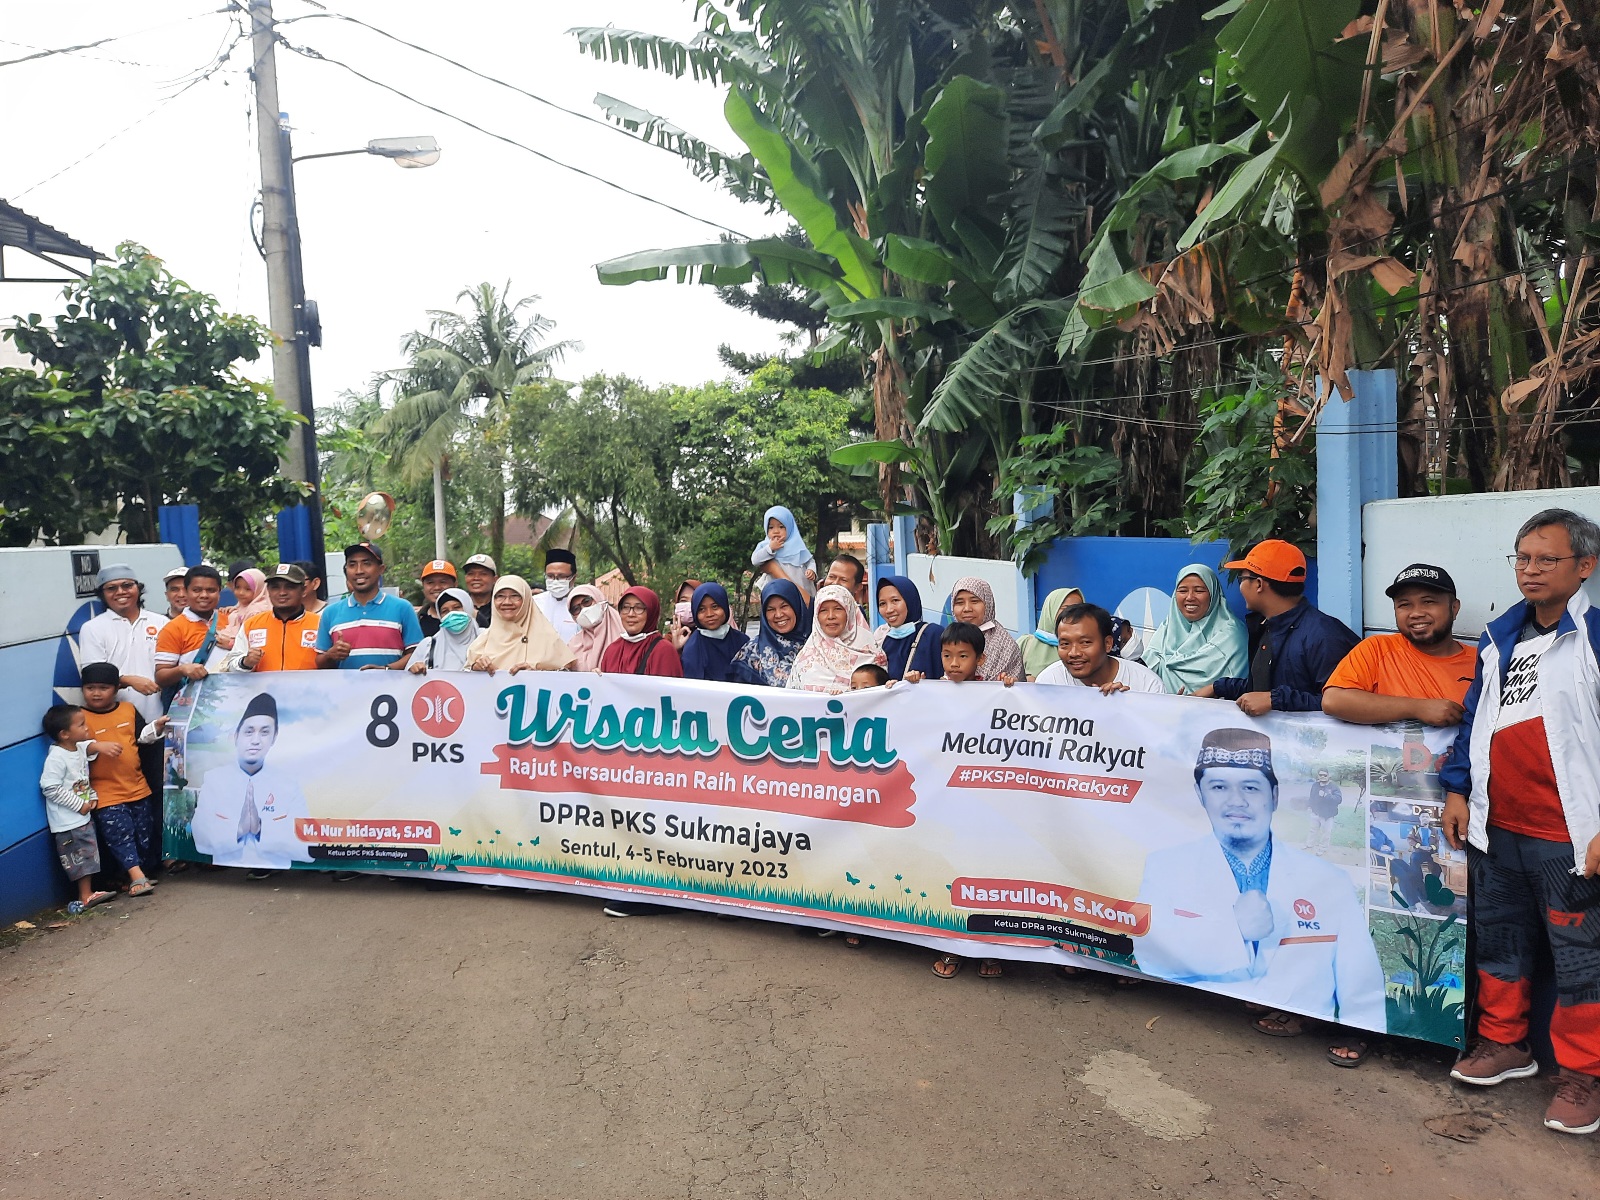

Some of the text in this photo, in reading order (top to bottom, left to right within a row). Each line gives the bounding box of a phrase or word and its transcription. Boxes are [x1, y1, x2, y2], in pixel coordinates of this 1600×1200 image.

[81, 555, 91, 573] NO
[75, 575, 98, 592] PARKIN
[366, 694, 400, 748] 8
[496, 684, 898, 766] Wisata Ceria
[990, 708, 1094, 736] Bersama
[412, 742, 465, 764] PKS
[941, 732, 1146, 772] Melayani Rakyat
[509, 757, 881, 807] Rajut Persaudaraan Raih Kemenangan
[959, 769, 1129, 797] #PKSPelayanRakyat
[303, 824, 433, 840] M. Nur Hidayat, S.Pd
[539, 802, 812, 855] DPRa PKS Sukmajaya
[375, 851, 407, 859] Sukmajaya
[560, 839, 788, 879] Sentul, 4-5 February 2023
[960, 884, 1137, 927] Nasrulloh, S.Kom
[994, 919, 1107, 945] Ketua DPRa PKS Sukmajaya
[1297, 921, 1321, 930] PKS
